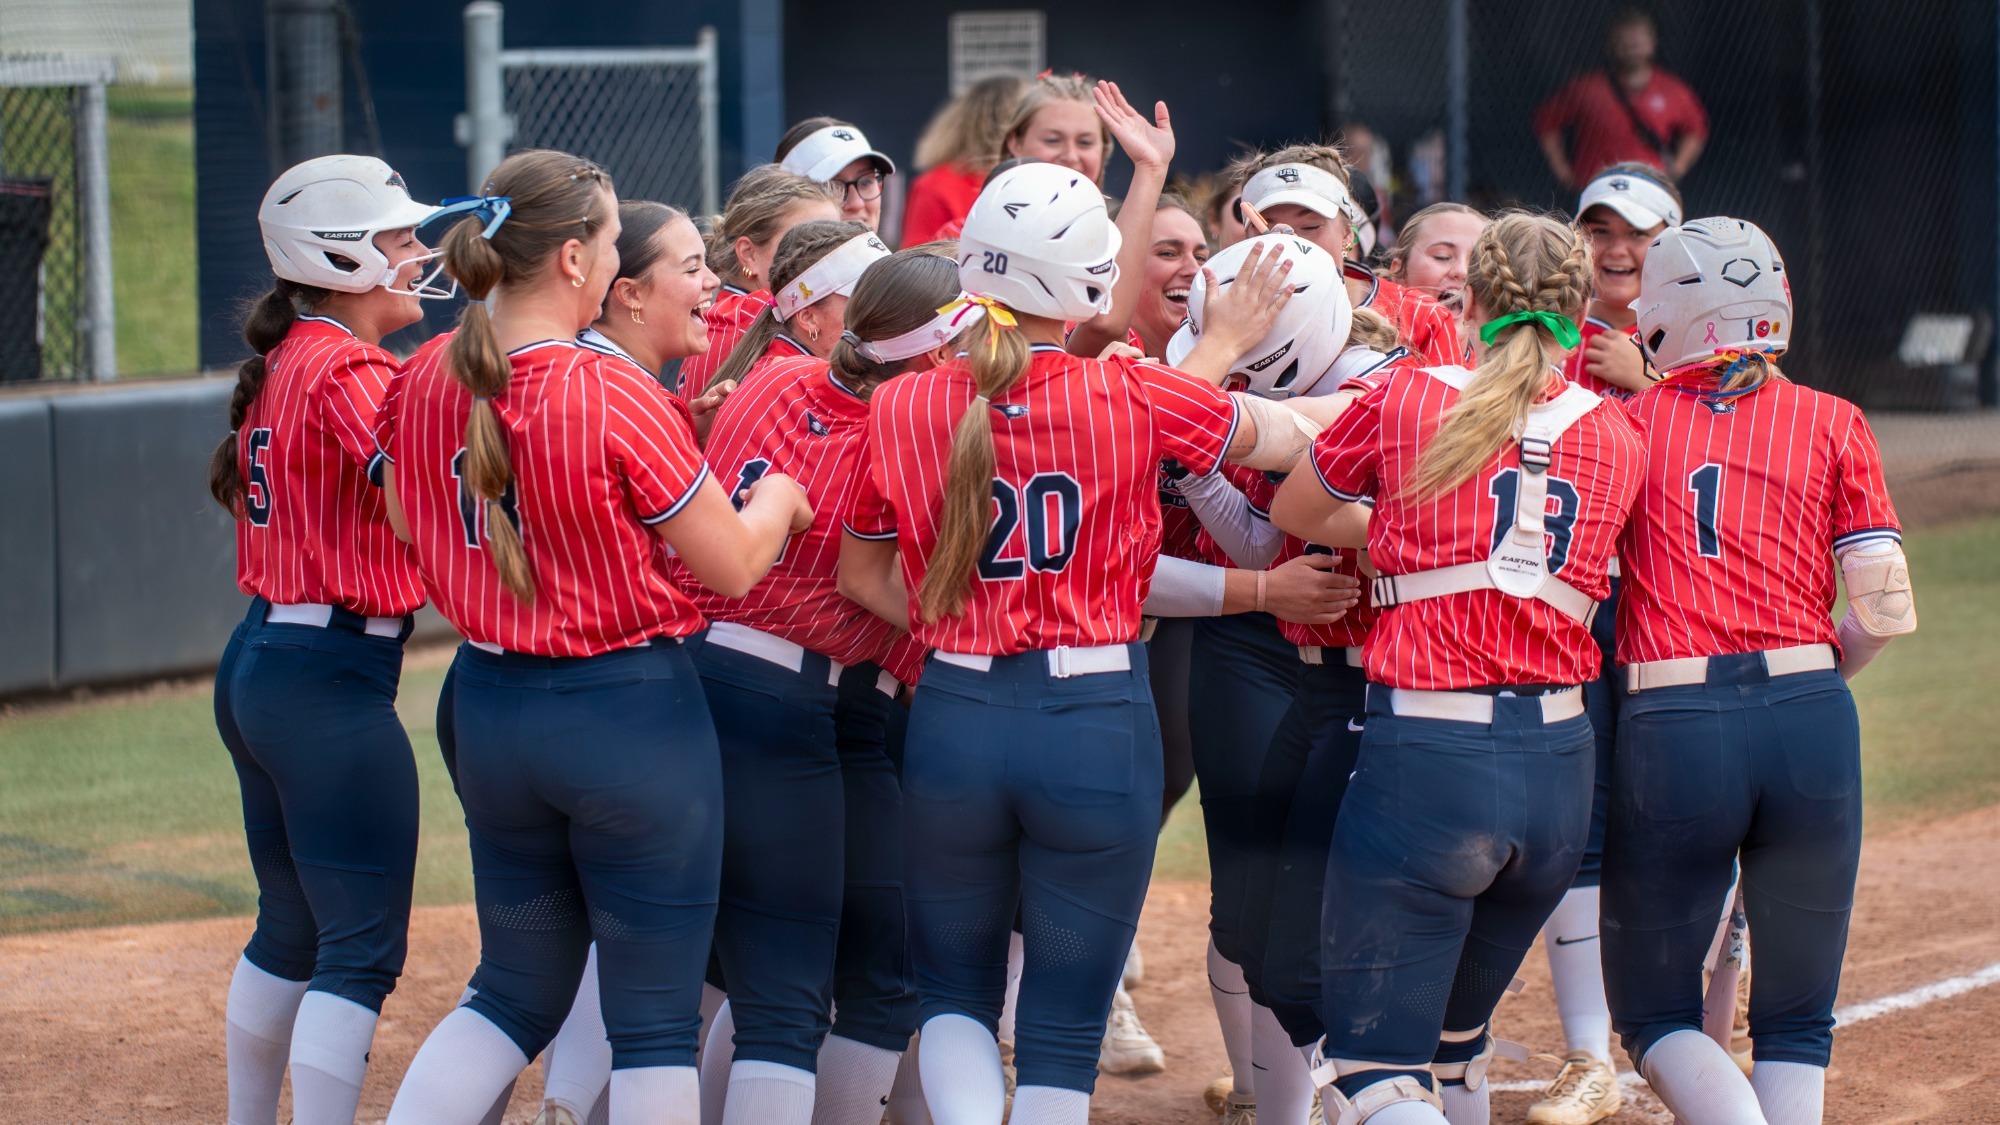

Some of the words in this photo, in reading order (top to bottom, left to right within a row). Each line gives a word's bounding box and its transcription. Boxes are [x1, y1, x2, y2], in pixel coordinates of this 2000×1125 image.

[323, 232, 363, 240] EASTON
[983, 250, 1009, 275] 20
[1747, 318, 1755, 341] 1
[1253, 347, 1287, 370] EASTON
[248, 427, 273, 527] 5
[1688, 462, 1722, 559] 1
[975, 471, 1083, 582] 20
[1501, 555, 1539, 567] EASTON
